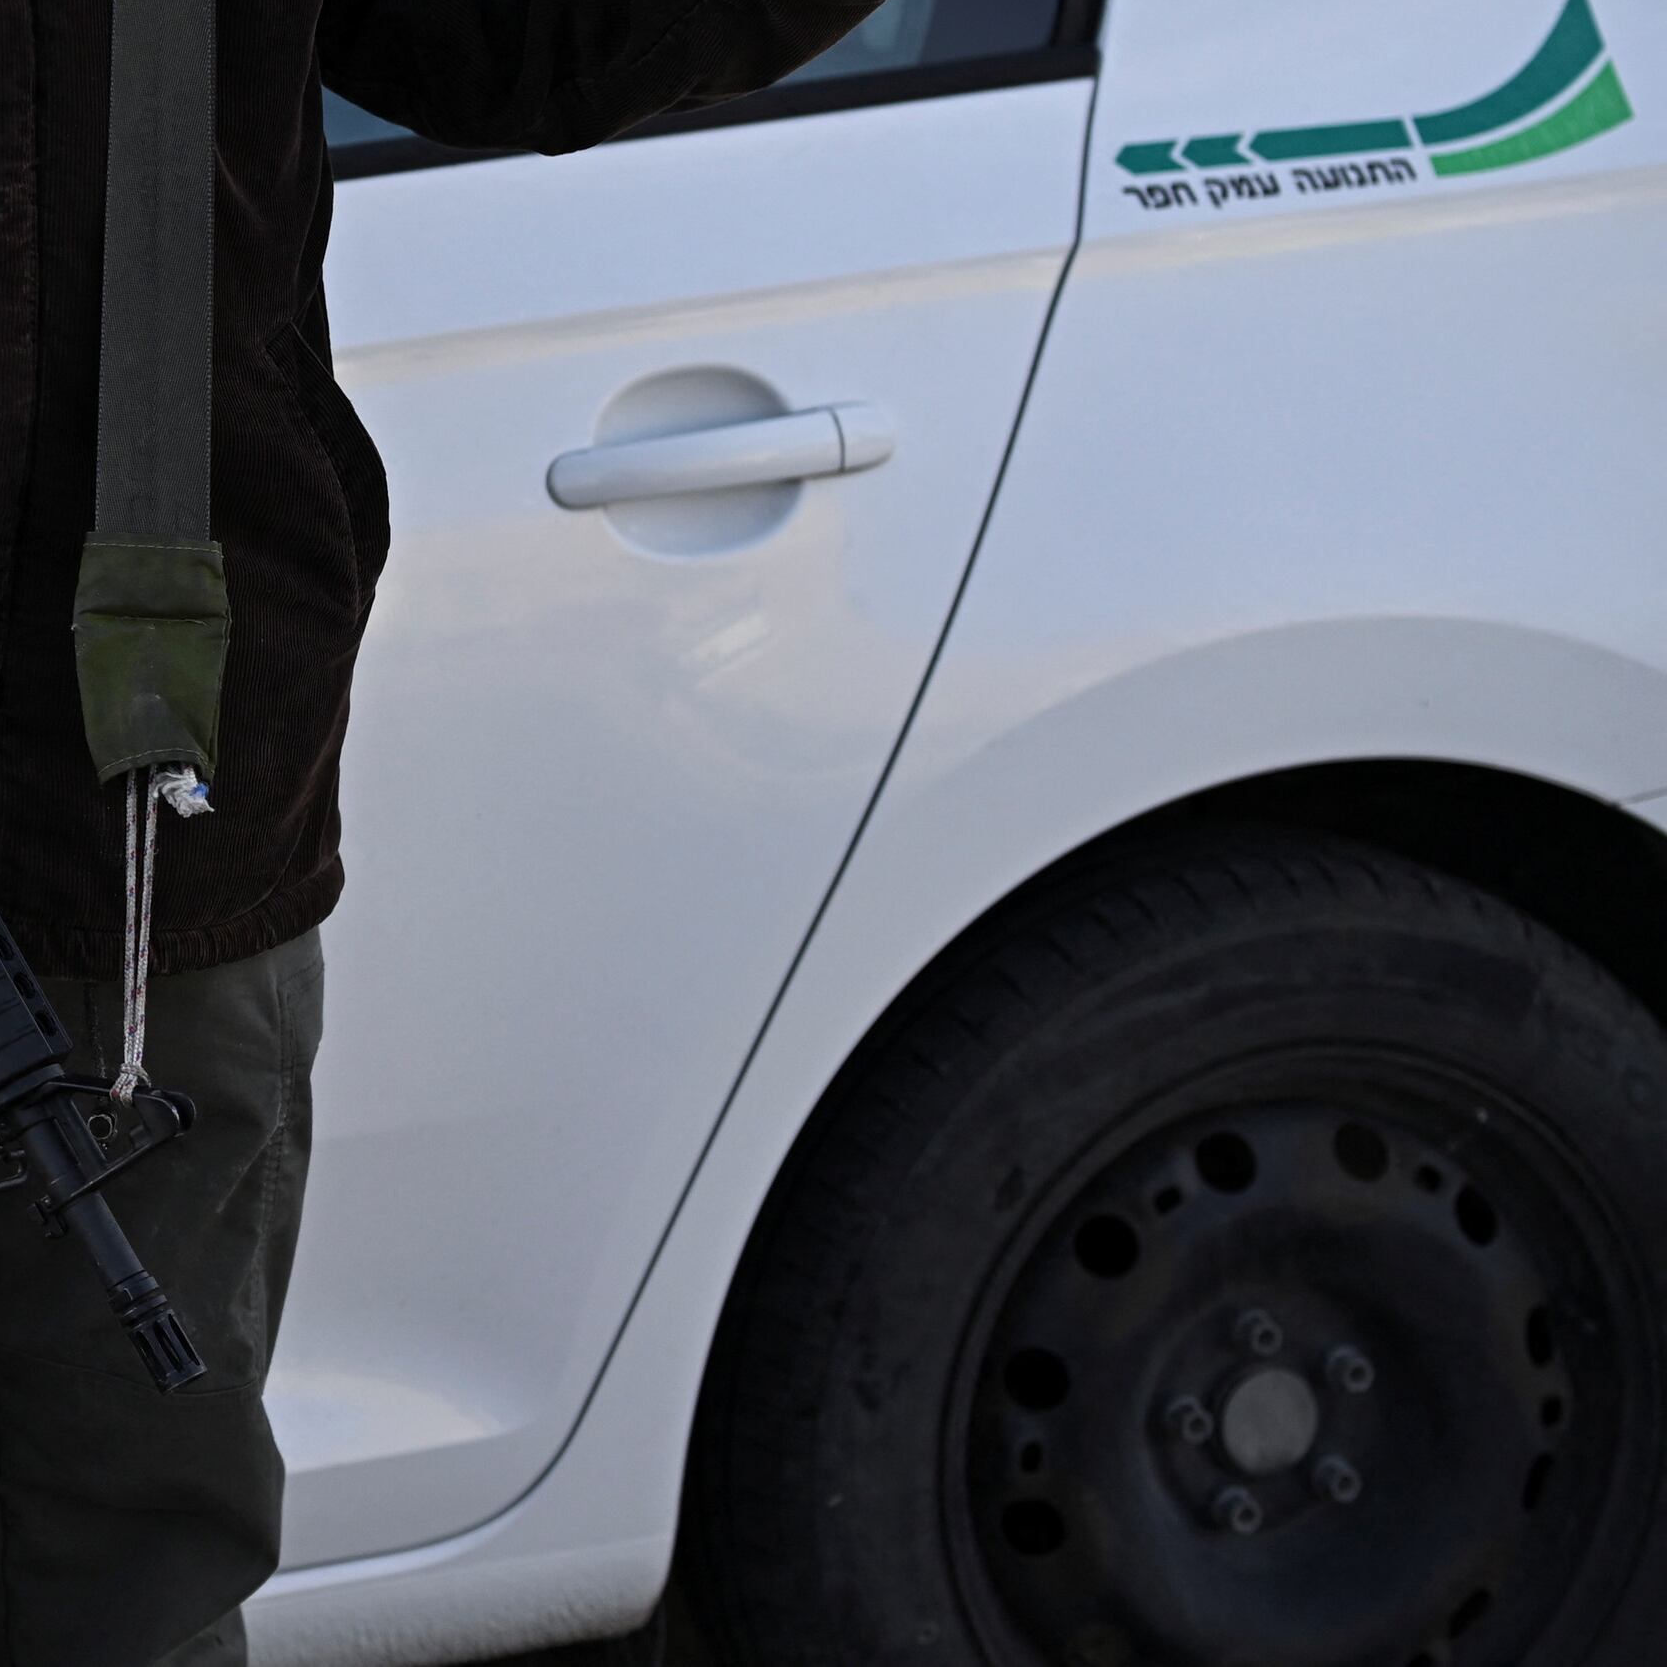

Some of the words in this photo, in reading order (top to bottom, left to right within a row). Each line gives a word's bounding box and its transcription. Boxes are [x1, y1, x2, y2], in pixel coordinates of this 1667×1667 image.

[1204, 173, 1281, 209] עמק
[1291, 157, 1418, 193] התנועה
[1123, 181, 1198, 210] חפר
